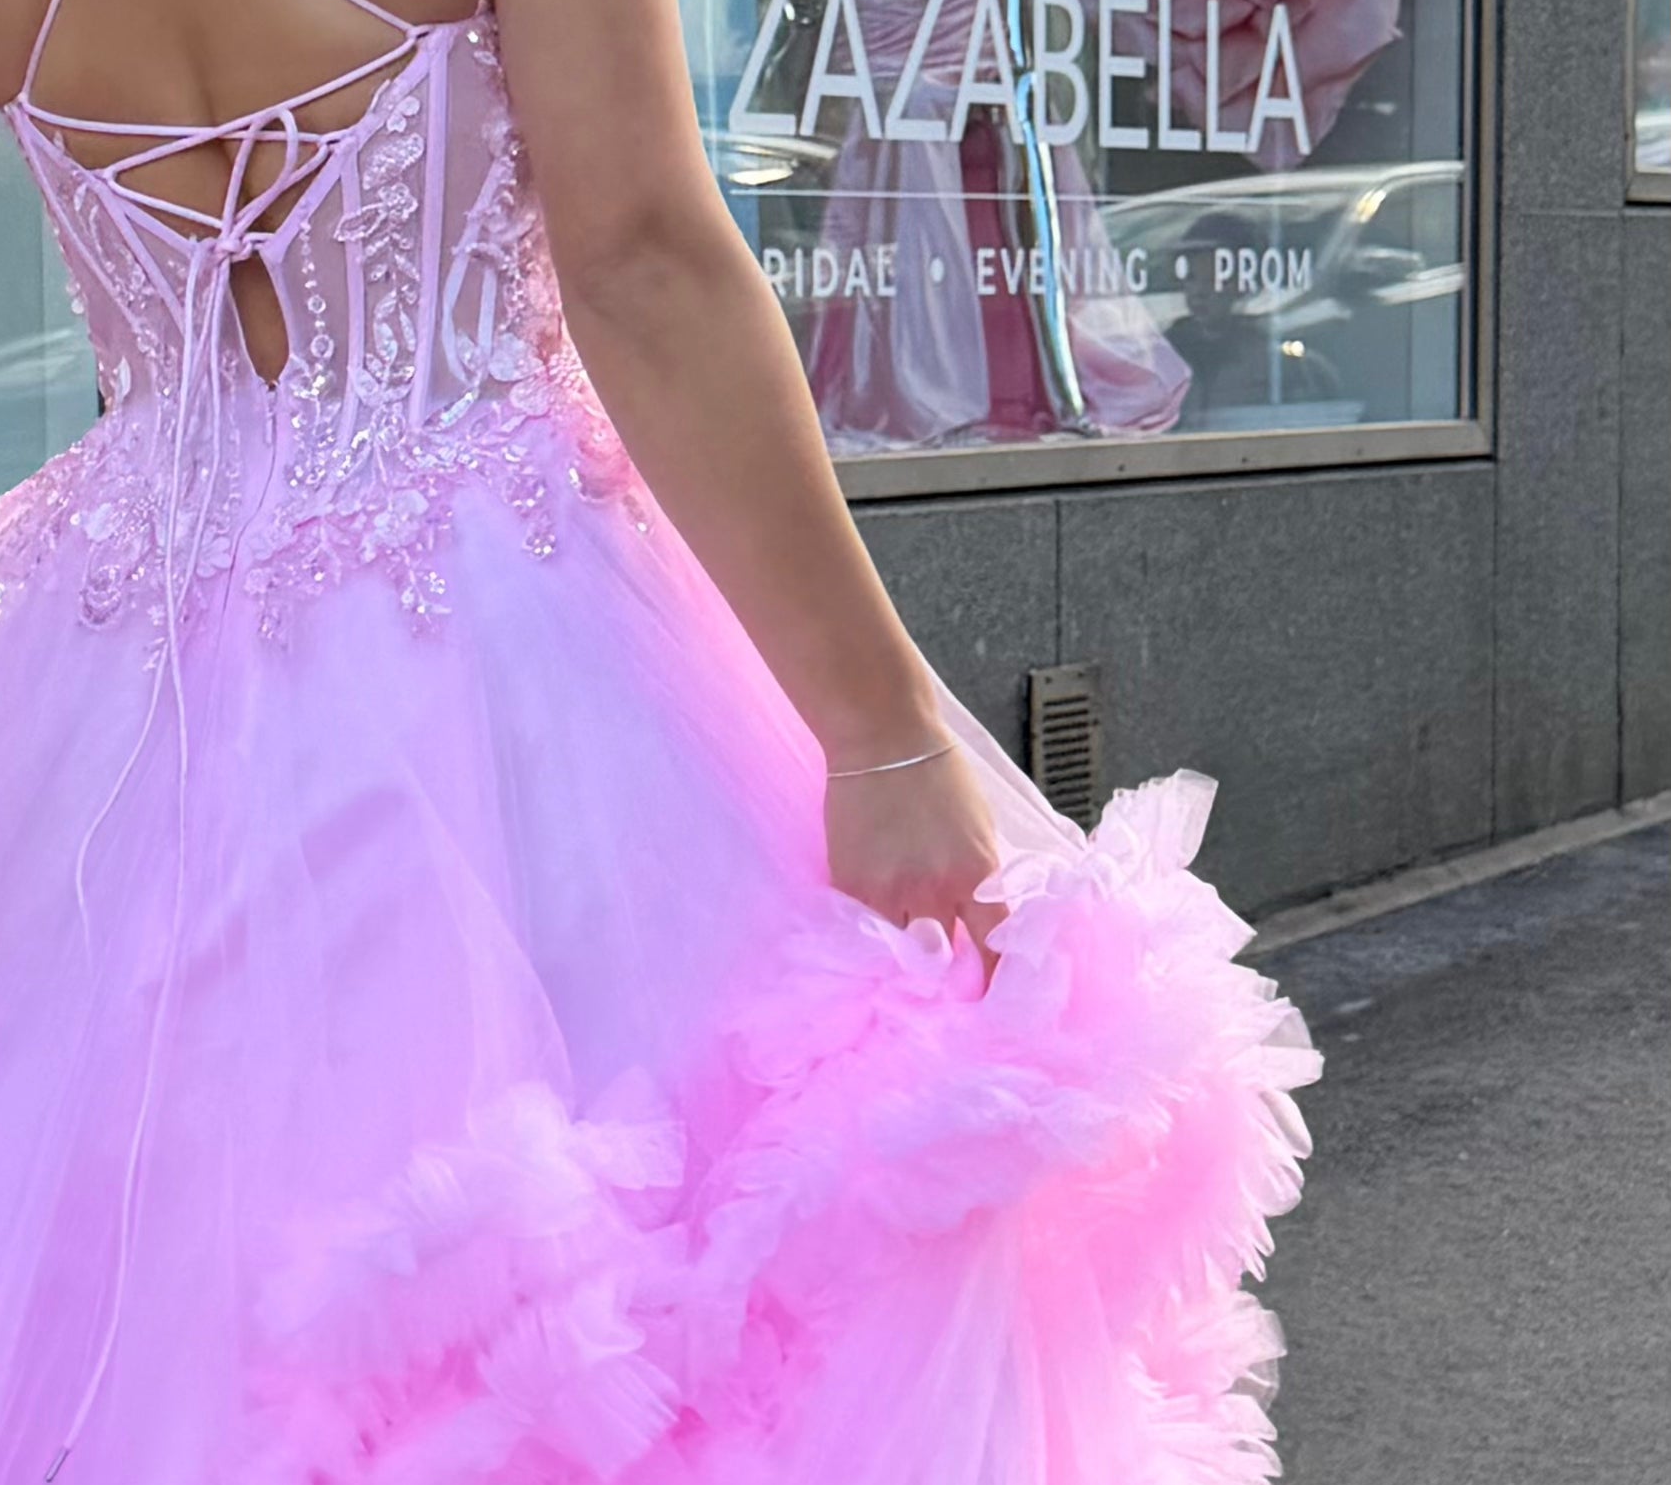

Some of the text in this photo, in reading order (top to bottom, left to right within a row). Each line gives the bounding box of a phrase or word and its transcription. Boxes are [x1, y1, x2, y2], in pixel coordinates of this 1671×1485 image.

[762, 246, 1313, 299] RIDAL EVENING PROM
